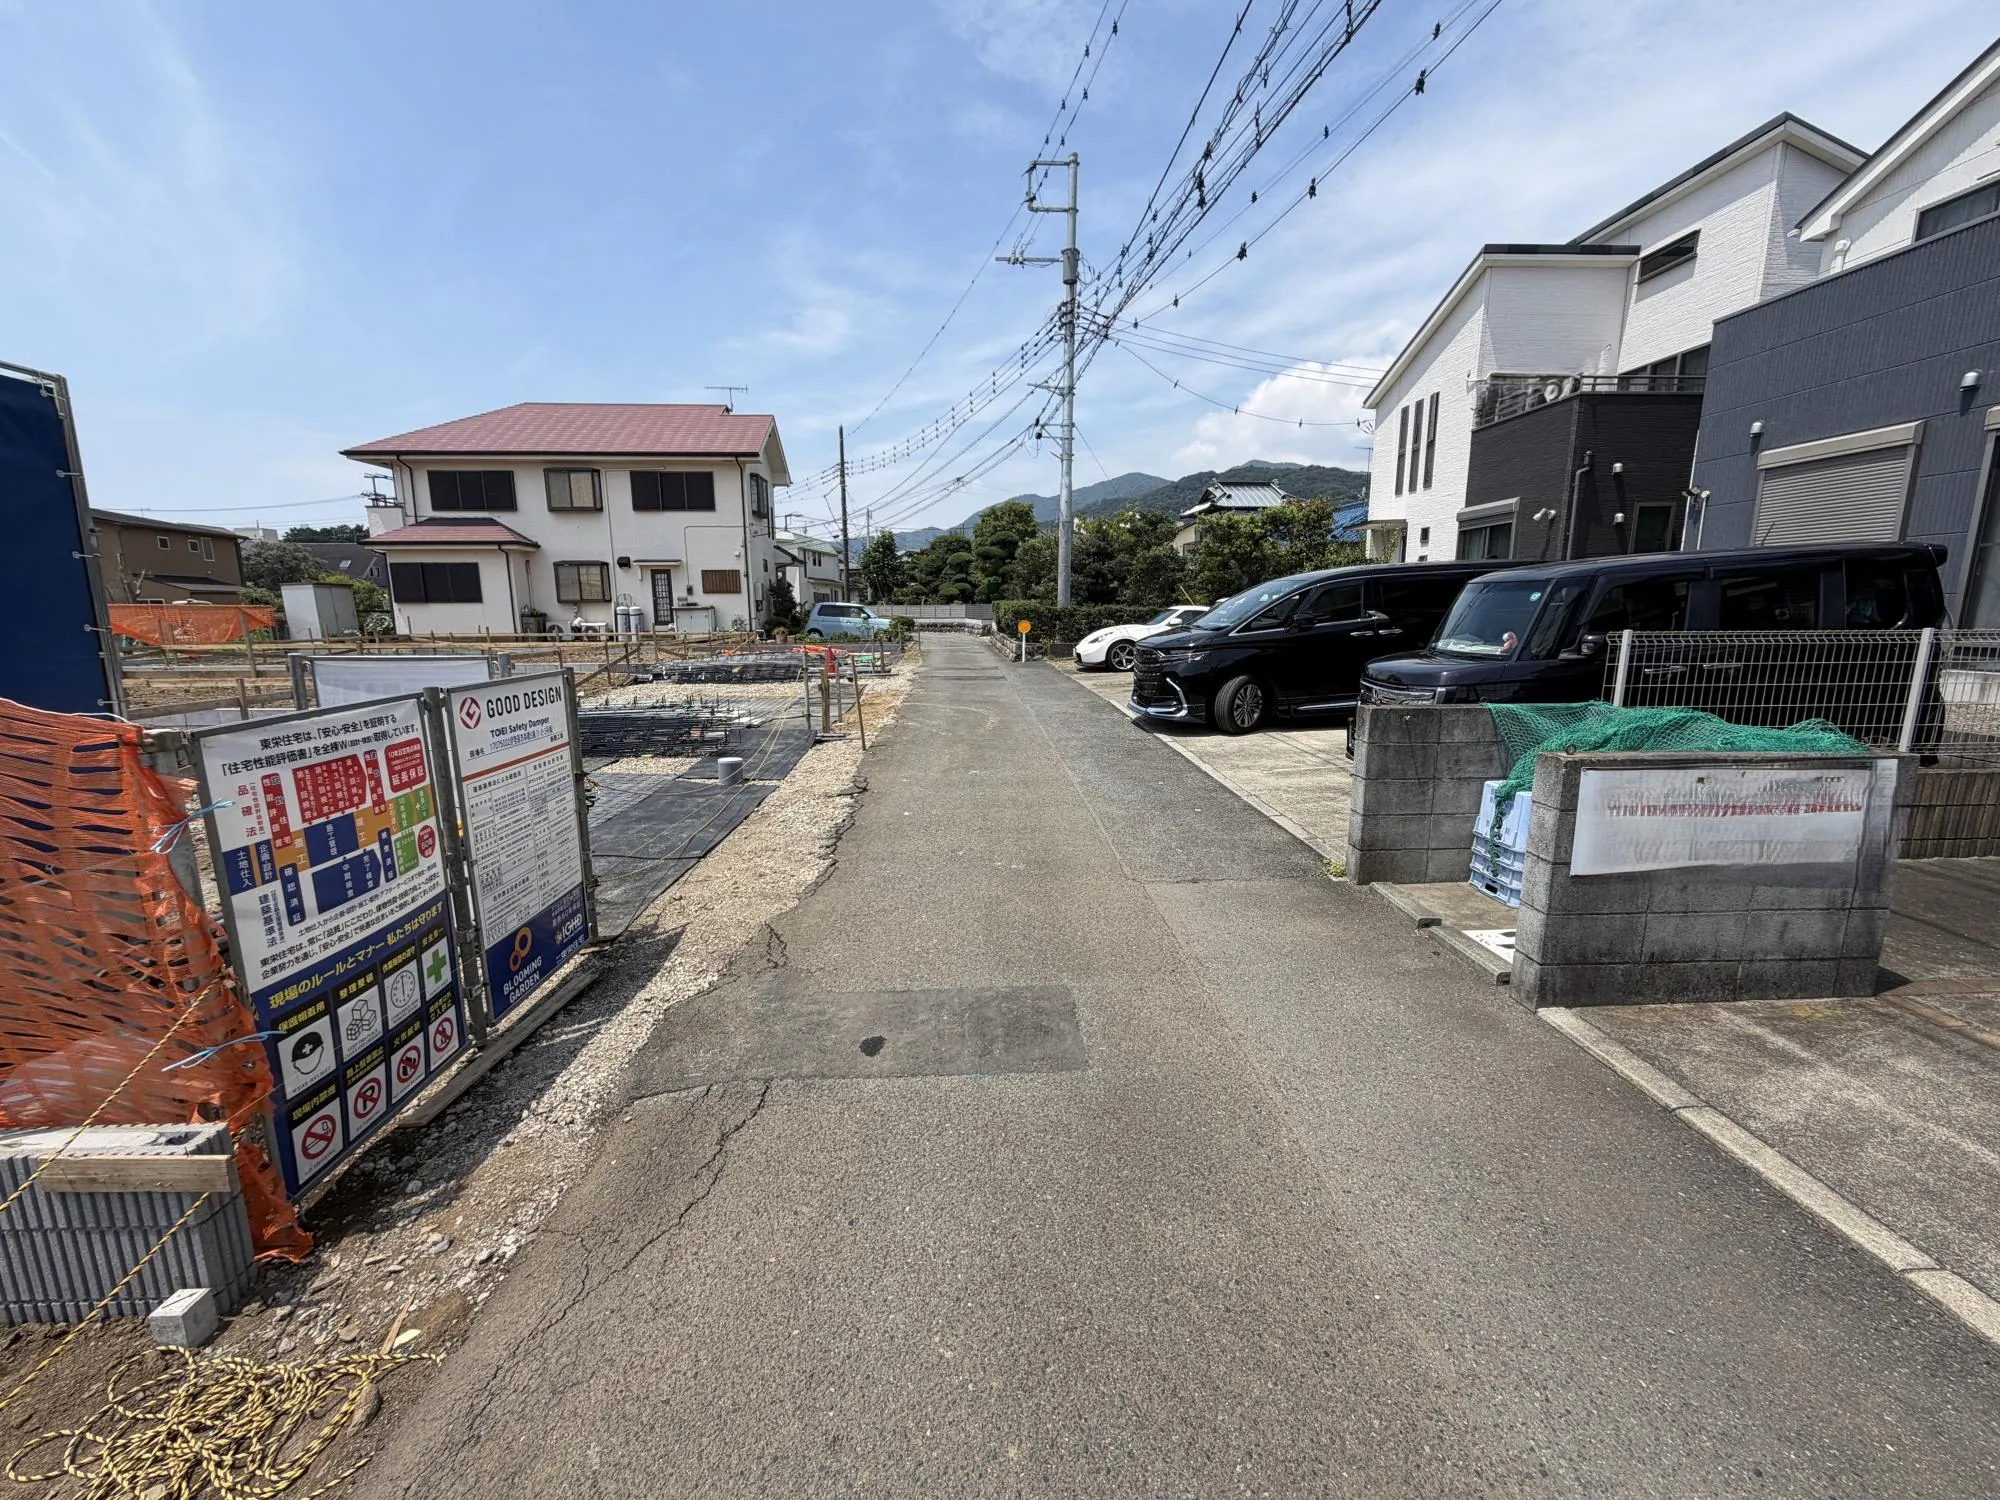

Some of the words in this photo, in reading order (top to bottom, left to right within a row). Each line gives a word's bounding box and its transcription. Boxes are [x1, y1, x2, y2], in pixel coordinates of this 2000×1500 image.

[485, 693, 521, 719] GOOD
[522, 685, 562, 709] DESIGN
[508, 720, 527, 735] Safety
[527, 715, 550, 729] Damper
[390, 764, 425, 786] 延長保証
[236, 783, 257, 839] 品確法
[235, 848, 253, 889] 土地仕入
[267, 935, 385, 1013] 現場のルールとマナー
[385, 900, 443, 946] 私たちは守ります
[502, 954, 542, 996] BLOOMING
[508, 969, 540, 1005] GARDEN
